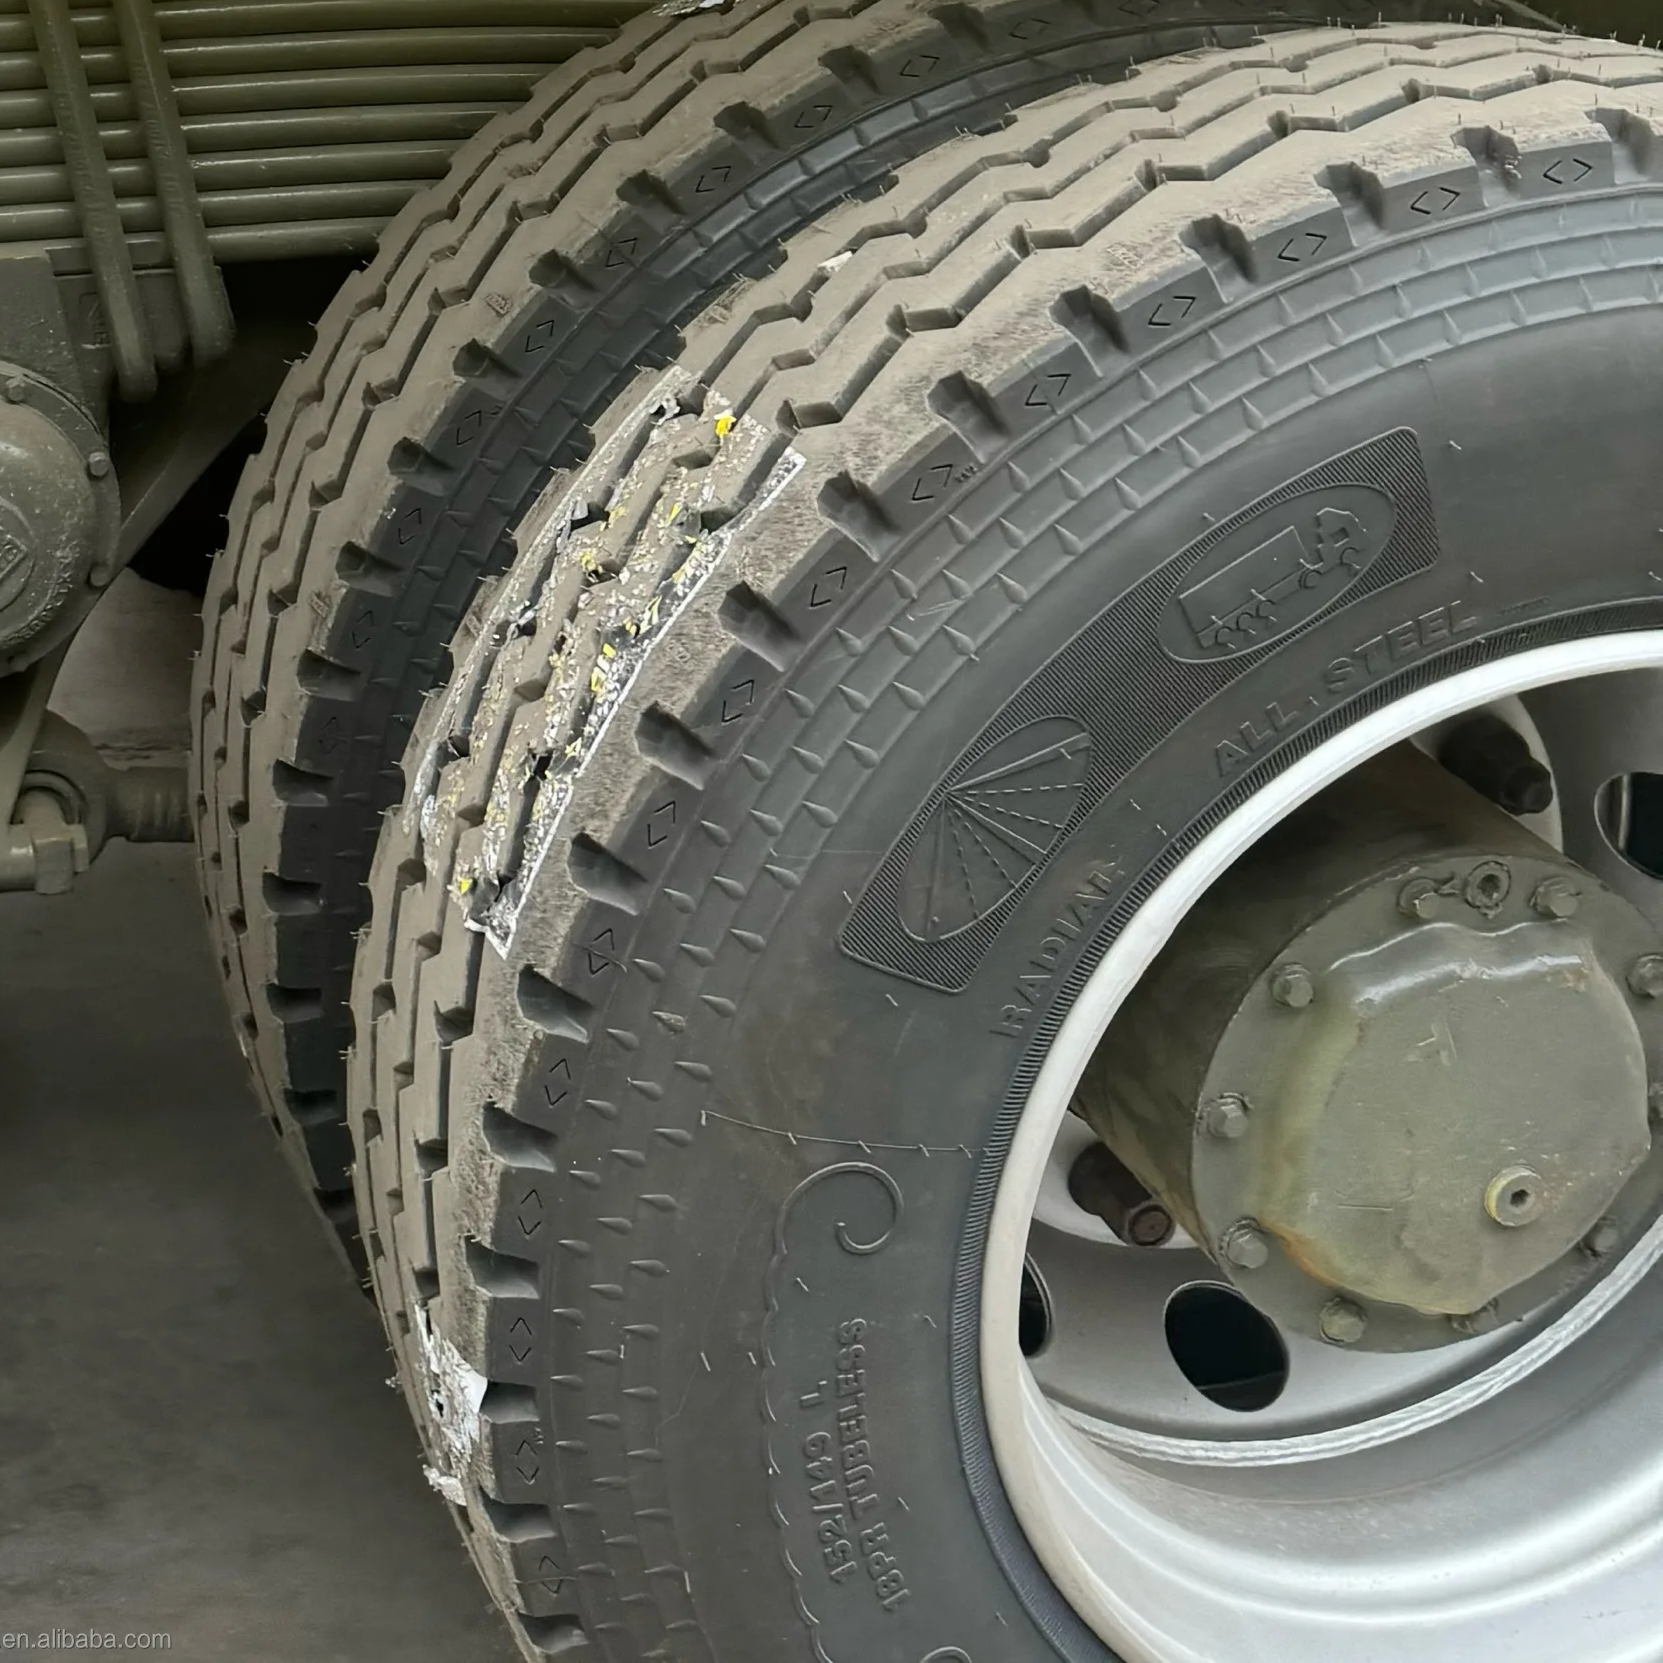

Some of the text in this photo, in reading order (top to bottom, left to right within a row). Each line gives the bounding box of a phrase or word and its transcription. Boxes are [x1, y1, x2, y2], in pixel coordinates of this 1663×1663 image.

[1213, 701, 1298, 778] ALL
[1324, 600, 1479, 695] STEEL
[803, 1431, 856, 1584] 152/149
[837, 1317, 912, 1614] 18PR TUBELESS
